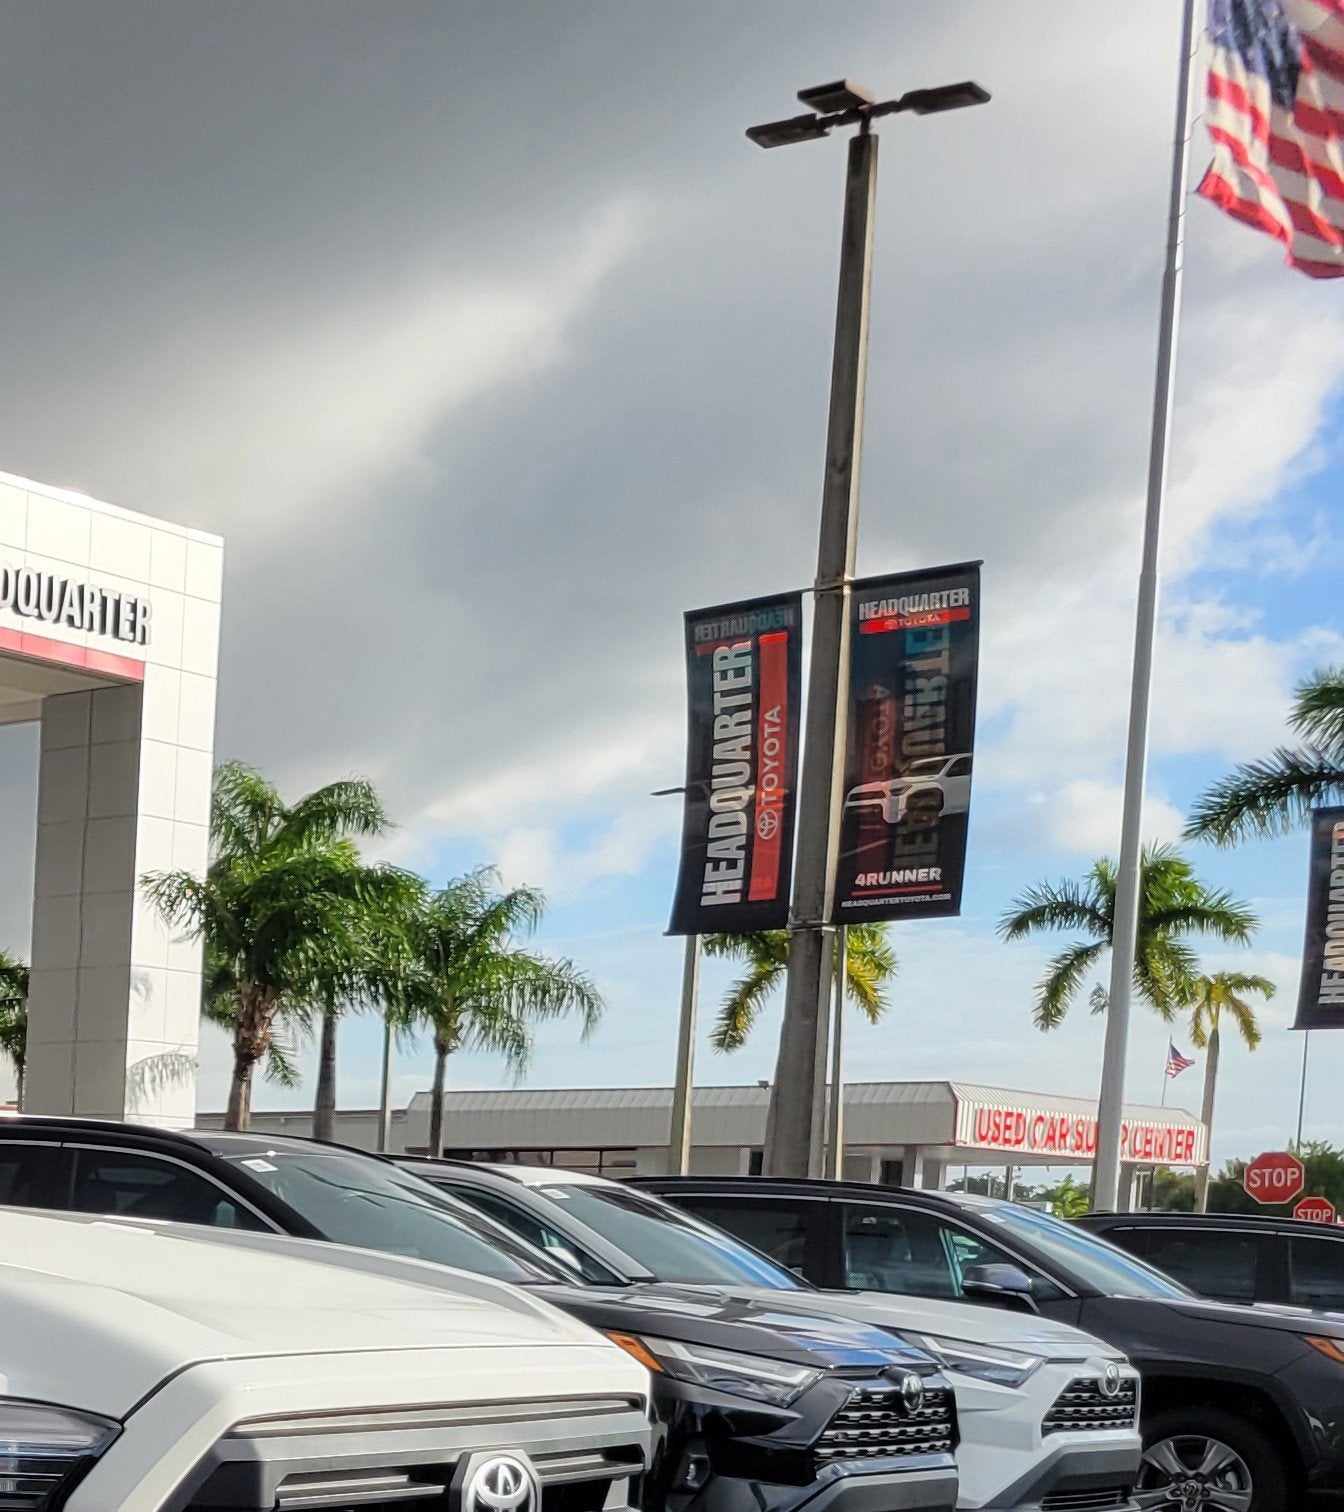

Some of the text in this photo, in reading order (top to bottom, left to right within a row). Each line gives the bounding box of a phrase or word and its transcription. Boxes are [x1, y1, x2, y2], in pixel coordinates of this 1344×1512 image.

[859, 587, 970, 620] HEADQUARTER
[899, 613, 940, 626] TOYOTA
[760, 705, 781, 807] TOYOTA
[700, 640, 753, 906] HEADQUARTER
[855, 867, 942, 887] 4RUNNER
[977, 1107, 1027, 1146] USED
[1031, 1115, 1070, 1150] CAR
[1132, 1125, 1195, 1161] CENTER
[1248, 1167, 1300, 1189] STOP
[1297, 1208, 1331, 1224] STOP
